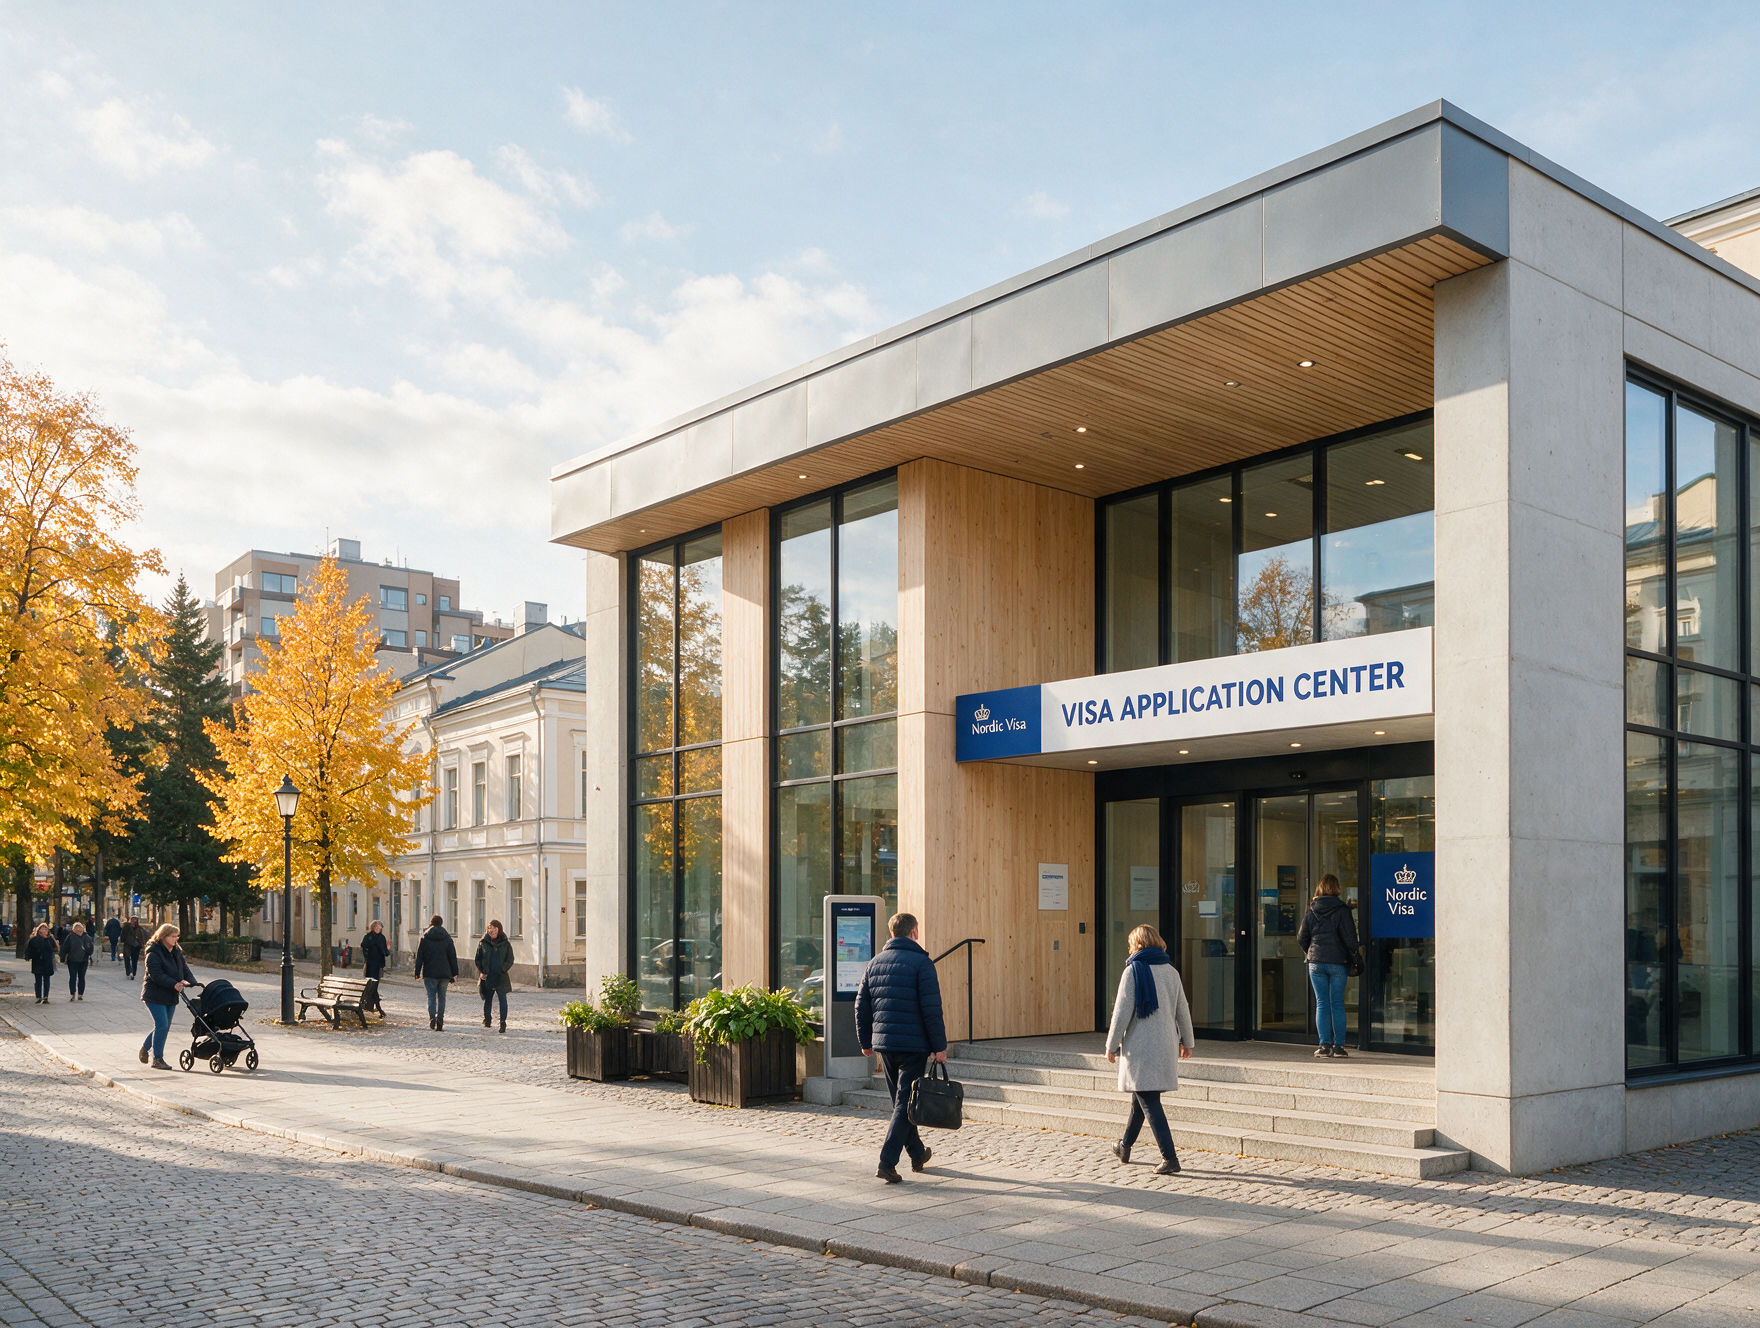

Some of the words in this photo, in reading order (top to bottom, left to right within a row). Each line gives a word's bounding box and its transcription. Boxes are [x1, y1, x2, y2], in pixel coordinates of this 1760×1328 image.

[1061, 698, 1115, 727] VISA
[1119, 676, 1284, 722] APPLICATION
[1293, 661, 1405, 701] CENTER
[971, 722, 1004, 735] Nordic
[1005, 717, 1027, 731] Visa
[1385, 886, 1427, 902] Nordic
[1387, 901, 1415, 915] Visa
